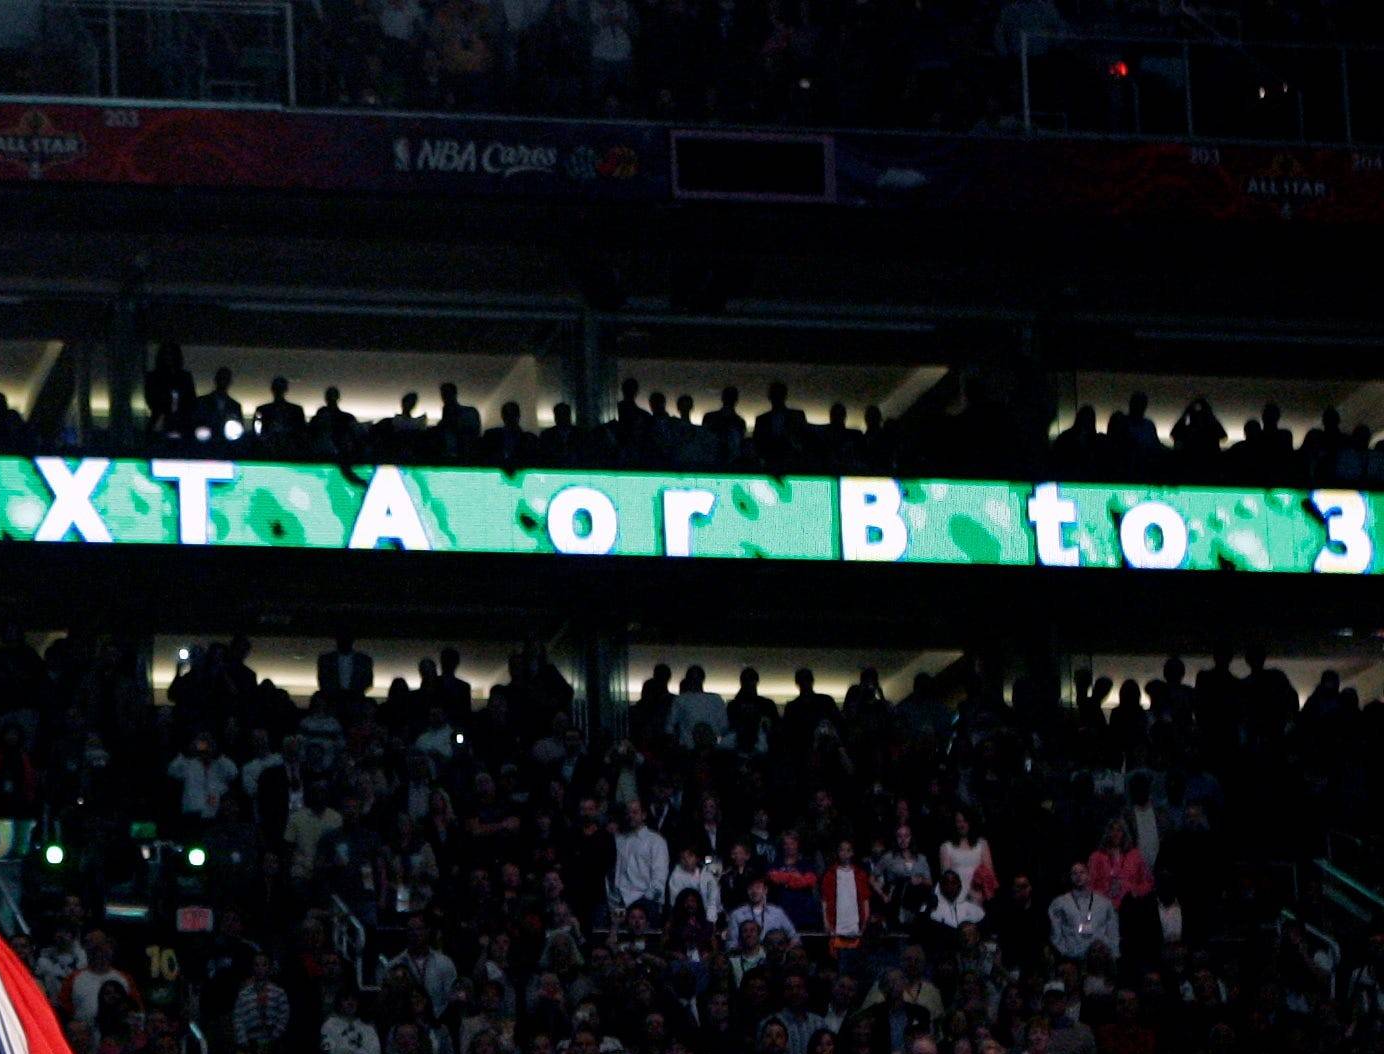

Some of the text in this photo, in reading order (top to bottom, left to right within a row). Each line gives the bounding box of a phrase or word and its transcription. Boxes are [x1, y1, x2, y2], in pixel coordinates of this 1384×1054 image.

[417, 138, 557, 178] NBA Cares
[347, 465, 433, 550] A
[546, 486, 714, 557] or
[839, 477, 908, 562] B
[1028, 482, 1187, 569] to
[1312, 489, 1374, 574] 3
